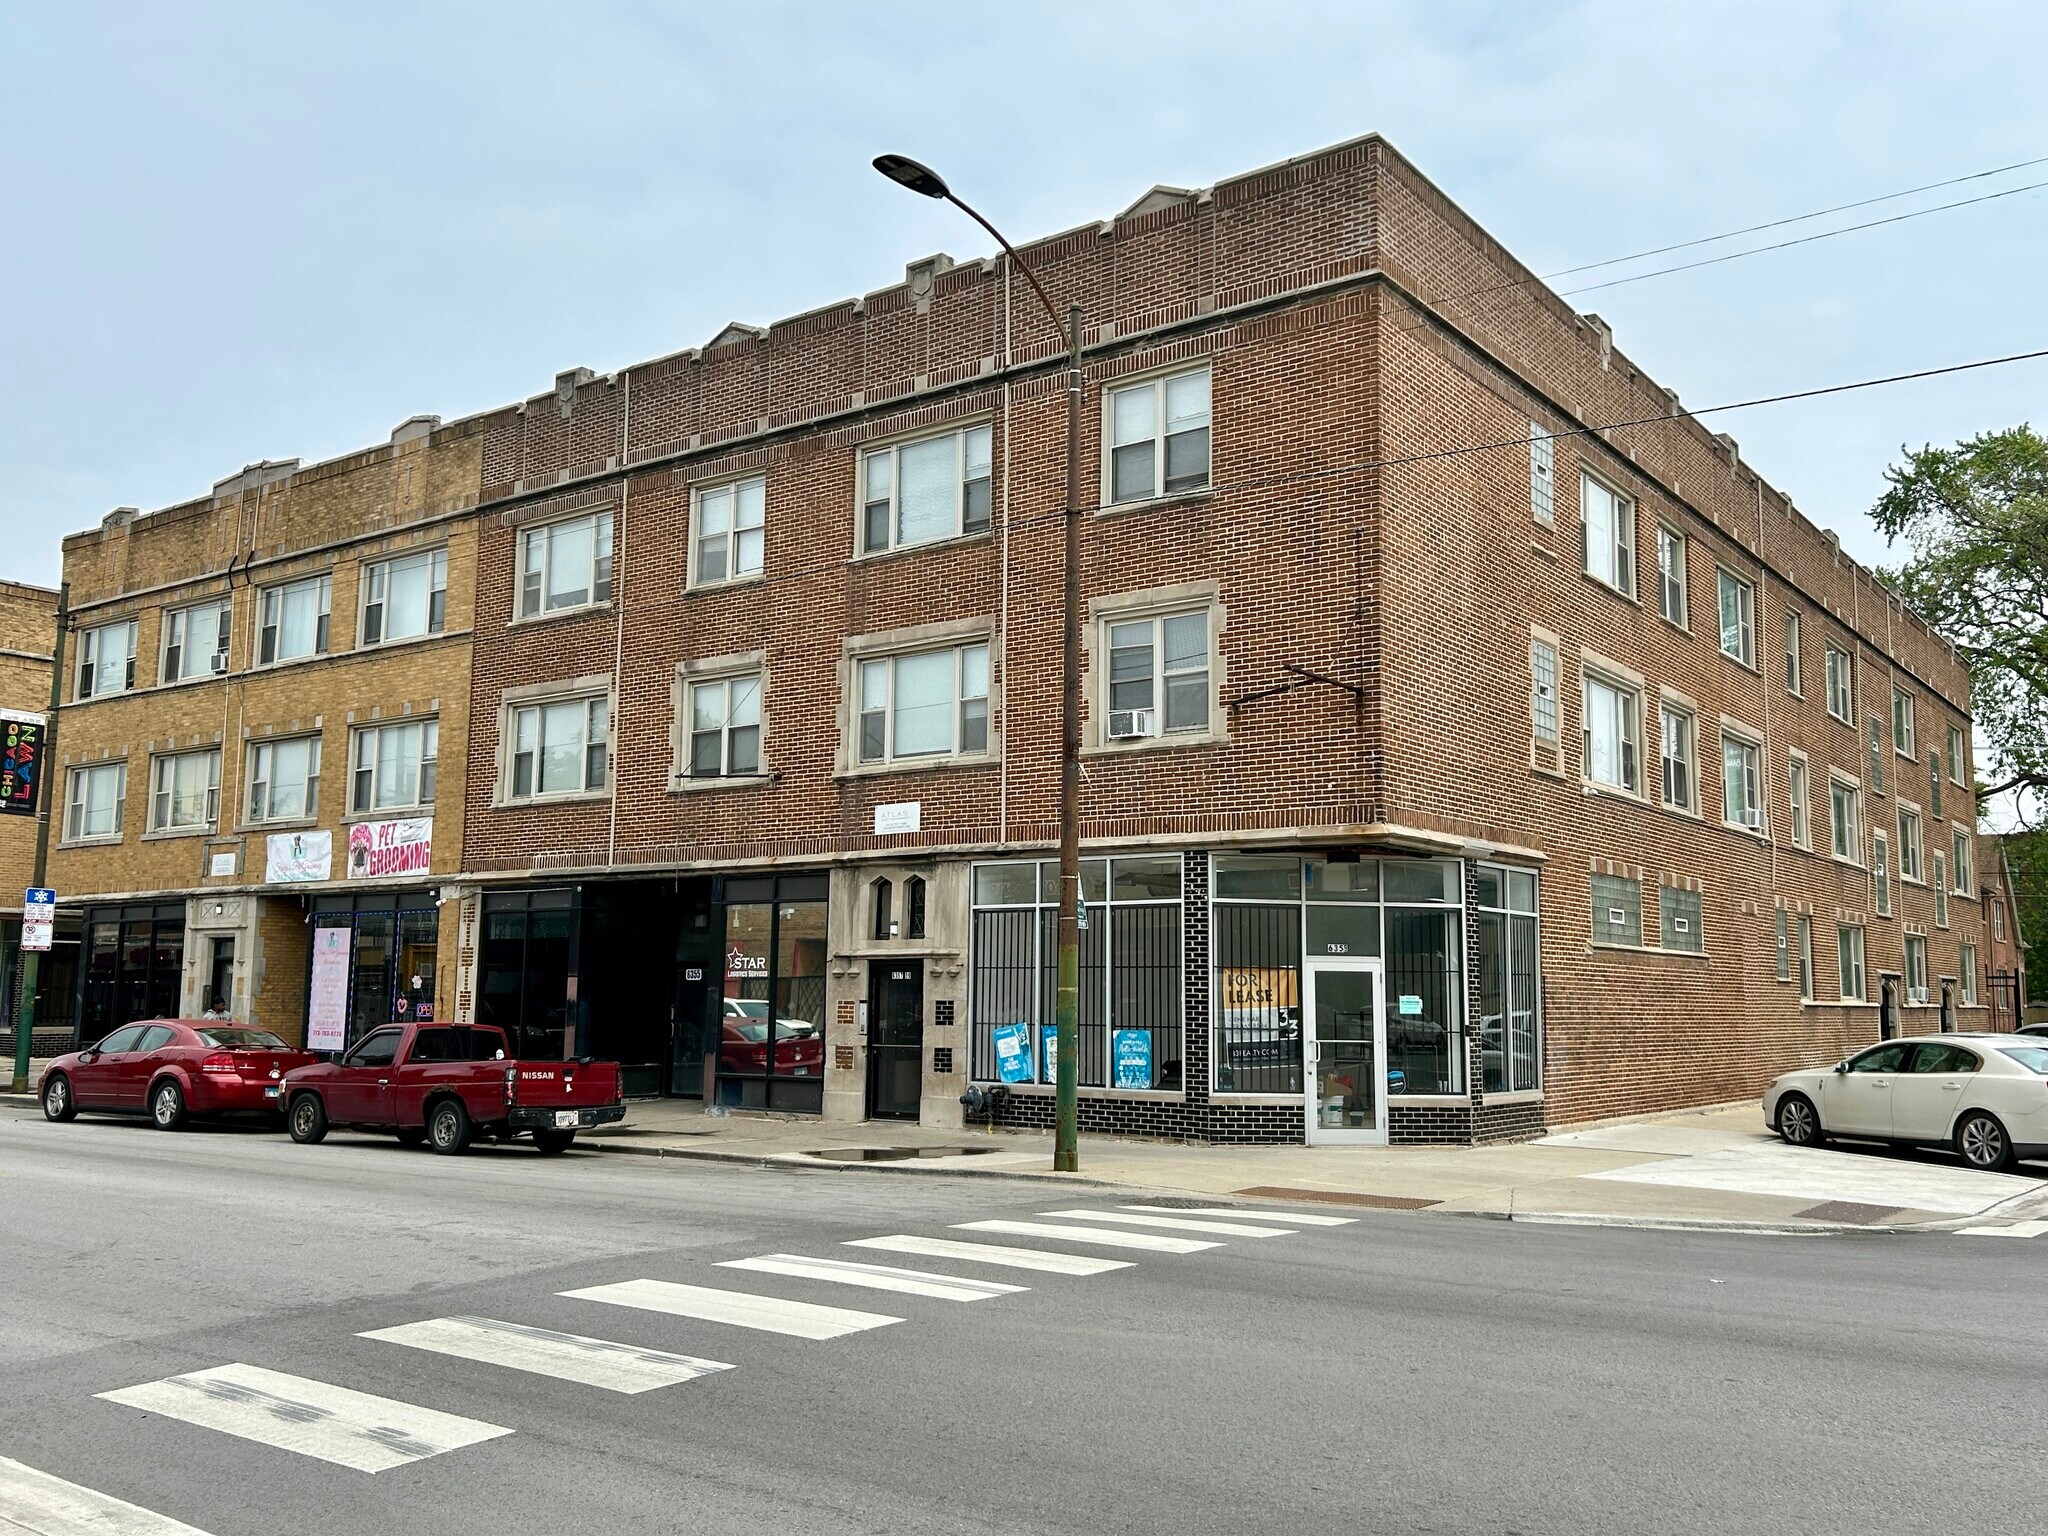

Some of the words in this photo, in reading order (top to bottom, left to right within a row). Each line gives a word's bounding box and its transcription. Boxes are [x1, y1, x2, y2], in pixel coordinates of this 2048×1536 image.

[0, 723, 19, 797] CHICAGO
[13, 725, 37, 800] LAWN
[881, 810, 909, 819] ATLAS
[378, 822, 397, 848] PET
[369, 840, 430, 877] GROOMING
[1327, 944, 1348, 953] 6359
[734, 957, 766, 969] STAR
[686, 969, 701, 979] 6355
[1228, 974, 1258, 987] FOR
[1228, 989, 1273, 1004] LEASE
[522, 1071, 555, 1079] NISSAN
